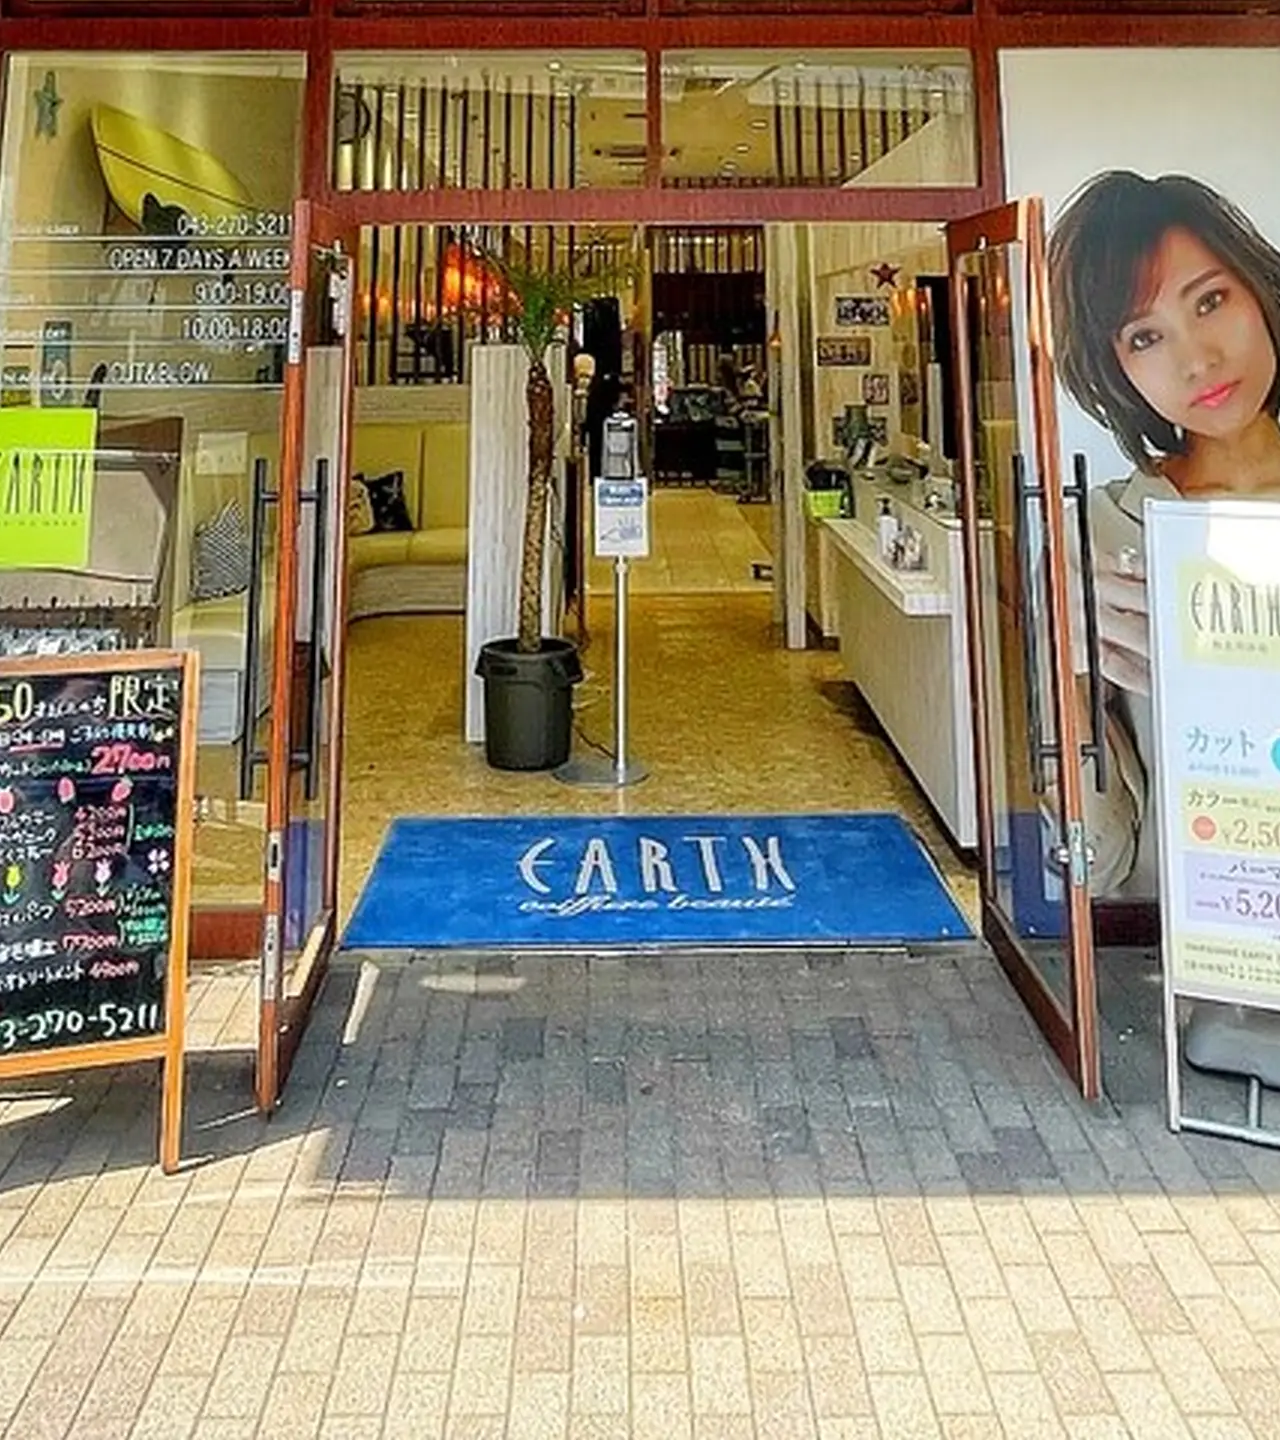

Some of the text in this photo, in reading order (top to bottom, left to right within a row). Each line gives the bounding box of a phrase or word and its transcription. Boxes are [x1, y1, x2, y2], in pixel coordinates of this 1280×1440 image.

[176, 248, 225, 269] DAYS
[228, 248, 242, 269] A
[1186, 726, 1256, 758] カット
[1187, 789, 1238, 808] カラー
[517, 835, 797, 894] EARTH
